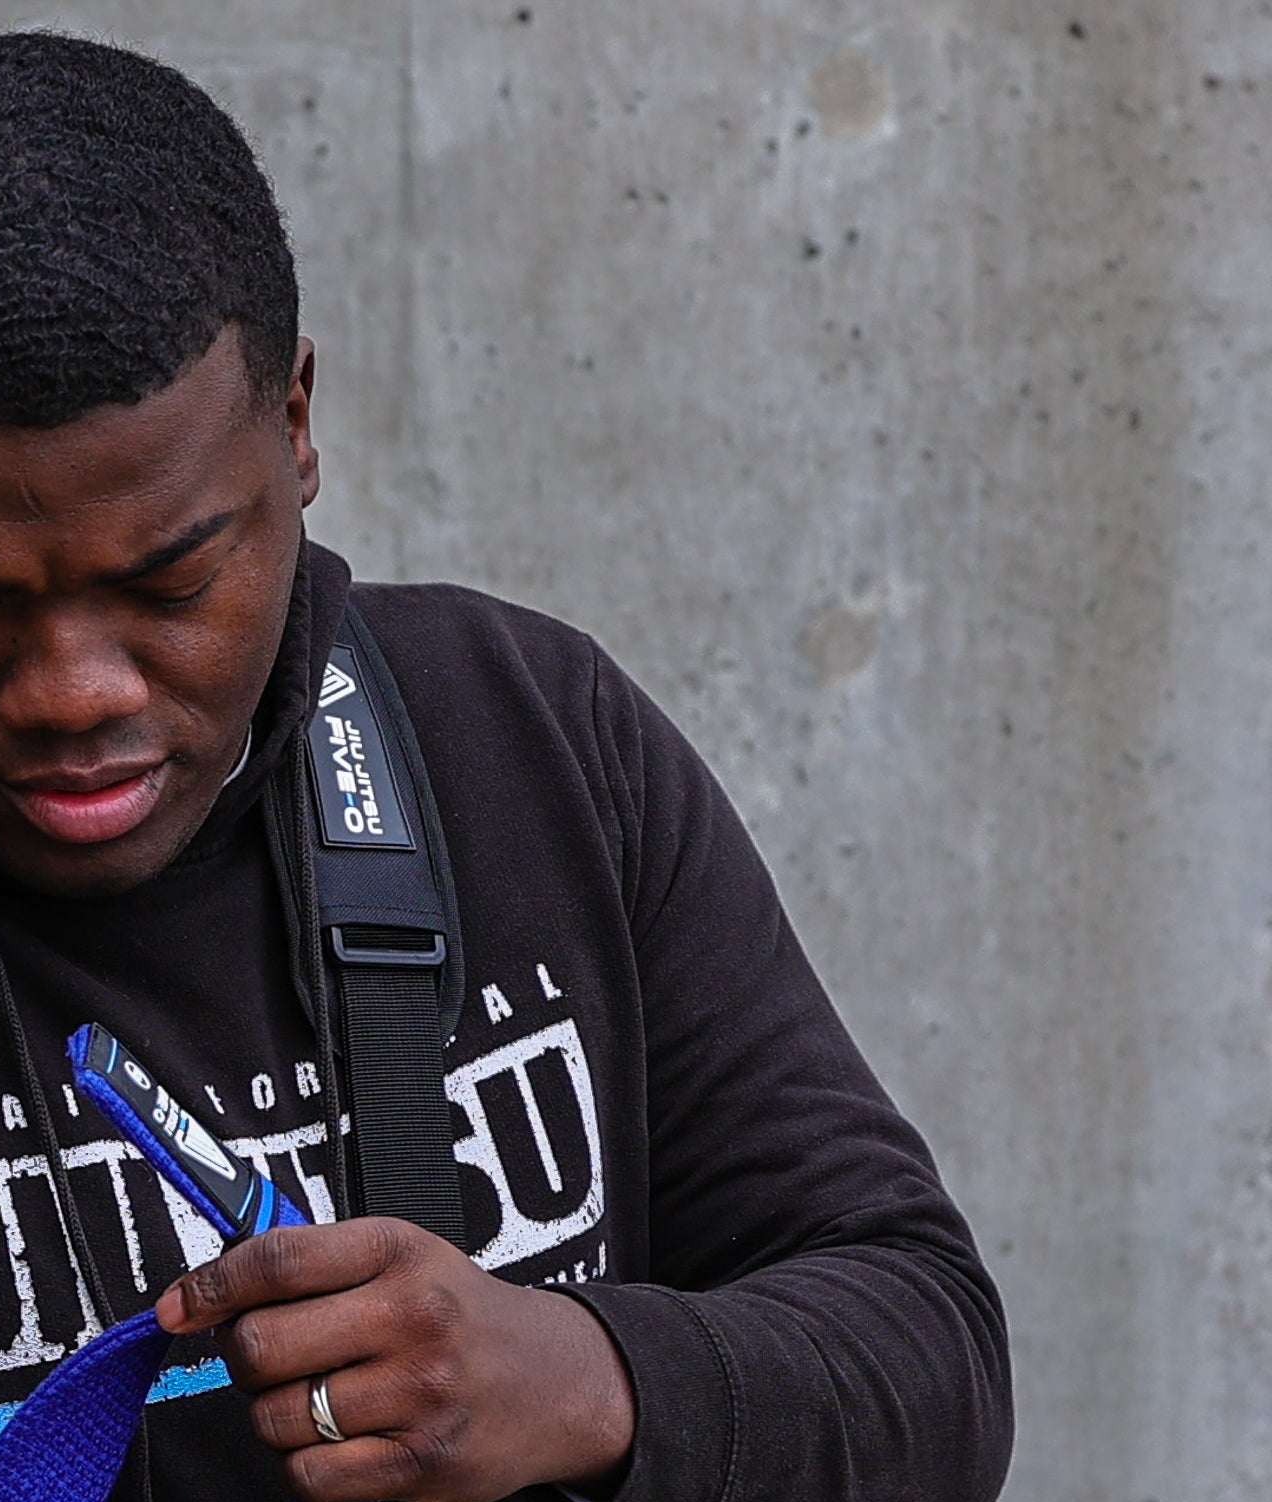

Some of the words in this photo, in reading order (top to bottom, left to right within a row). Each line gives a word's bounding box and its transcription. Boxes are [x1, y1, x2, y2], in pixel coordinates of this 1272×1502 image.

[324, 714, 365, 834] FIVE-O
[344, 719, 365, 760] JIU
[354, 764, 384, 835] JITSU
